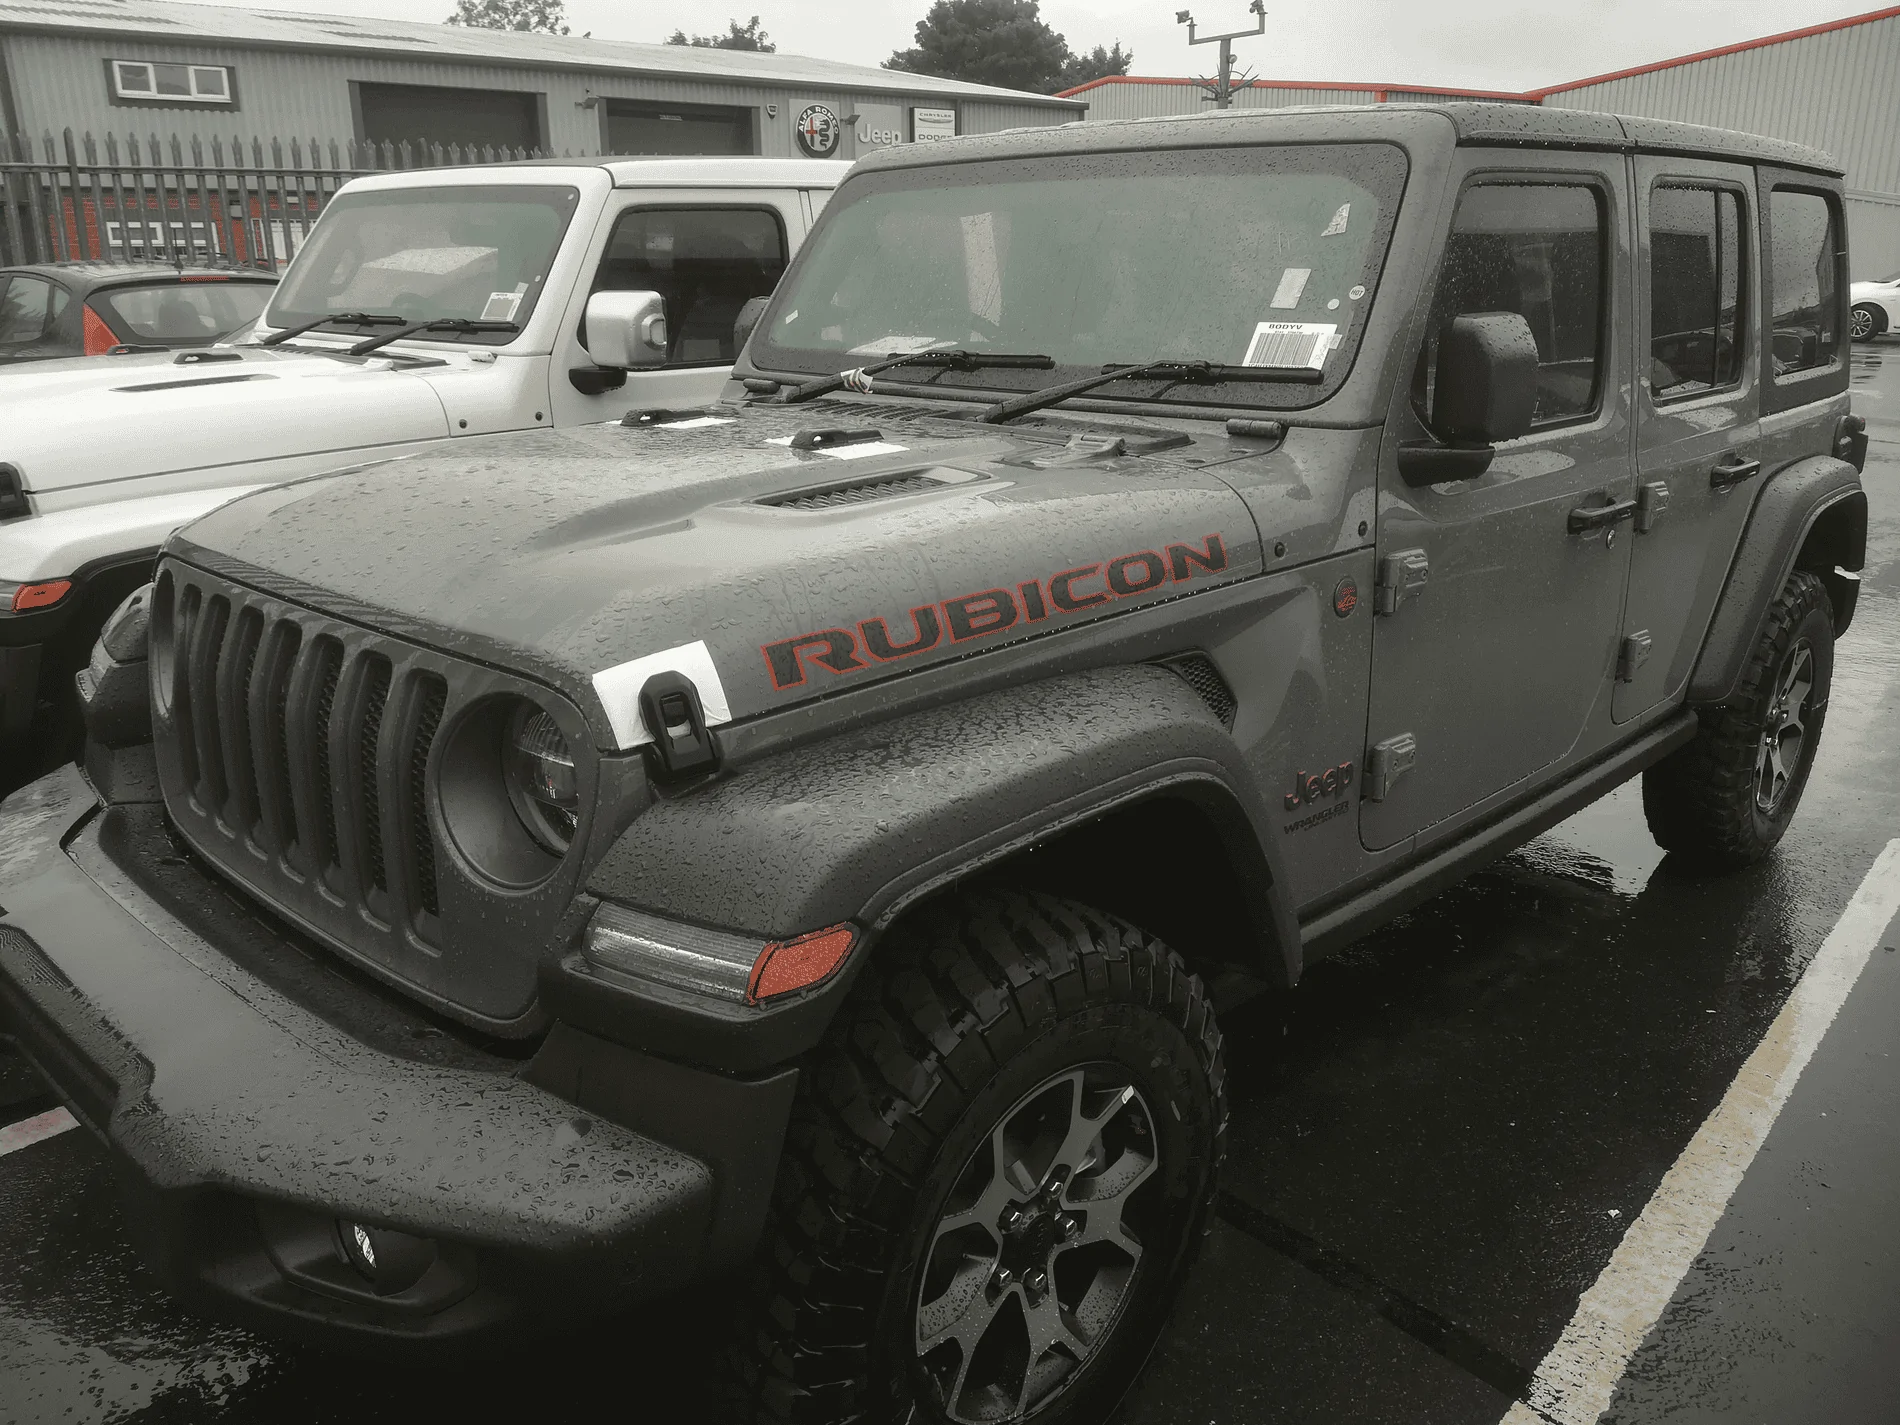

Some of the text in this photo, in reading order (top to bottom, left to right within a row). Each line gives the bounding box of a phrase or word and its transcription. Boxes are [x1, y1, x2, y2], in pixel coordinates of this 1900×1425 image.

[798, 106, 839, 134] ALFA ROMEO
[858, 123, 902, 145] Jeep
[761, 533, 1228, 691] RUBICON
[1284, 761, 1353, 811] Jeep
[1284, 800, 1349, 834] WRANGLER
